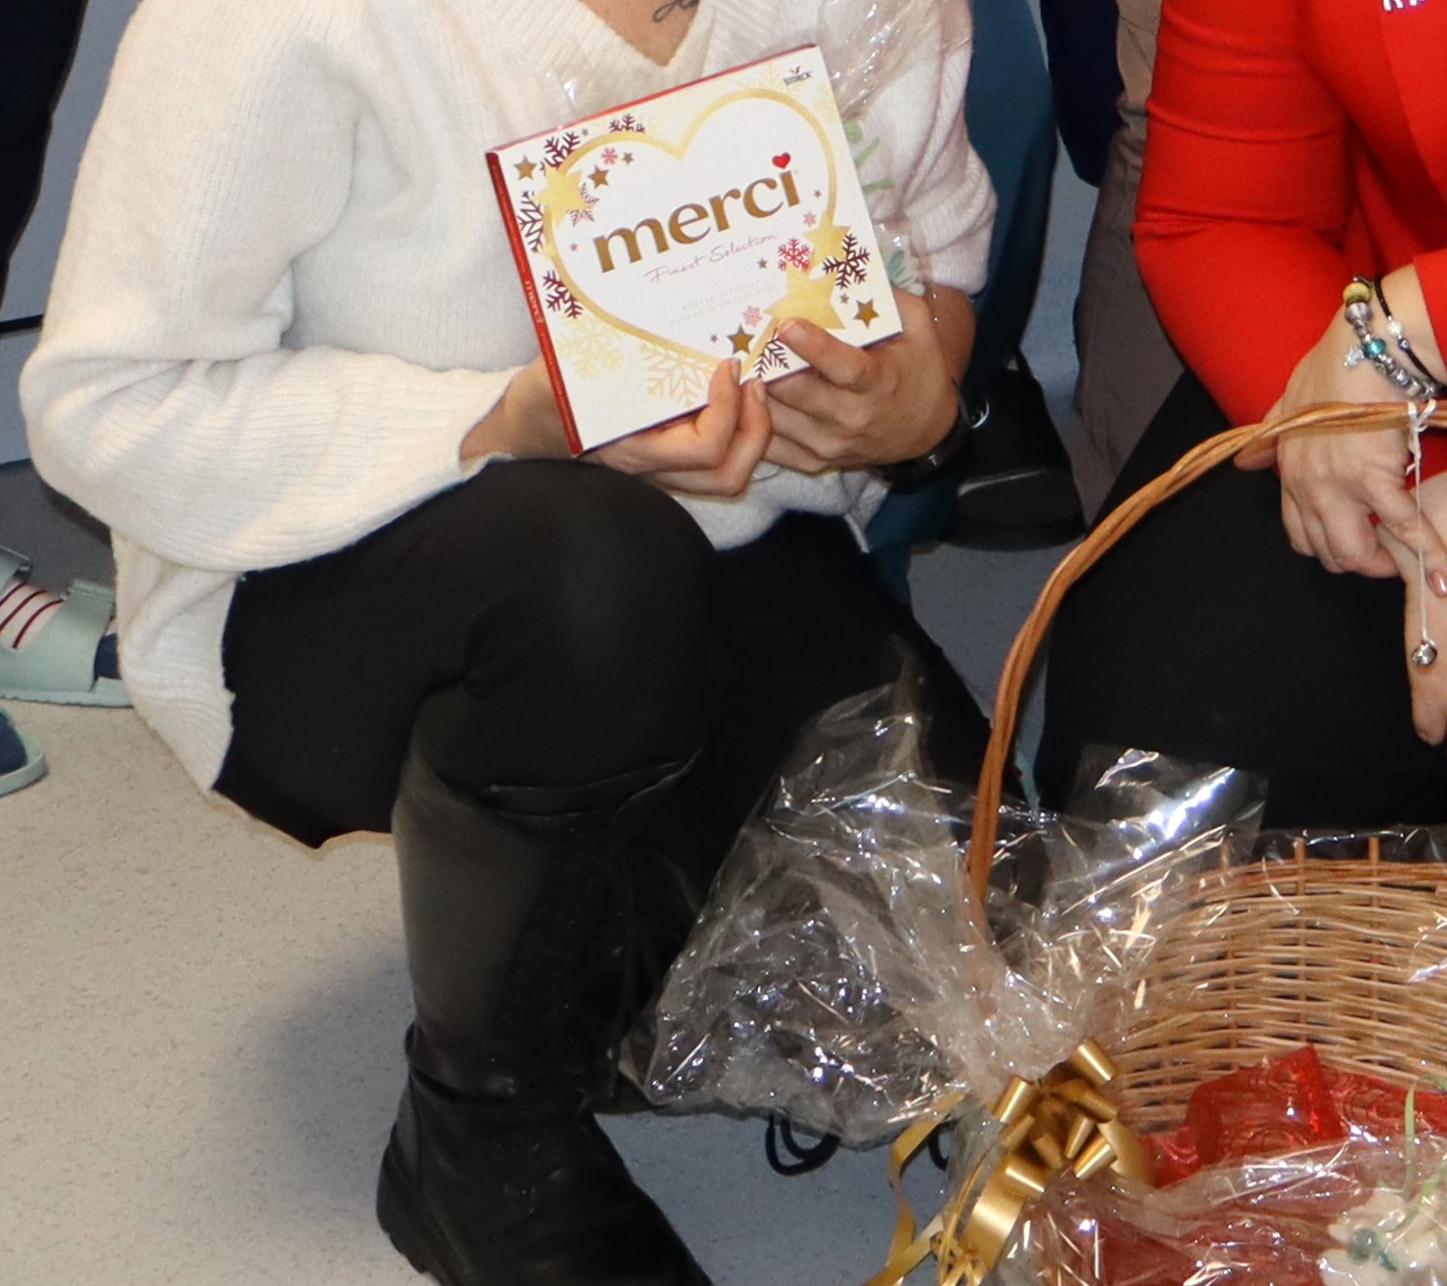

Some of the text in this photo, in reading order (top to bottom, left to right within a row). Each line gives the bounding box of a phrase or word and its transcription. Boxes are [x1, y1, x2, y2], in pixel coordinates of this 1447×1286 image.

[592, 151, 801, 275] merci
[644, 234, 778, 284] Finest Selection
[524, 279, 545, 325] merci
